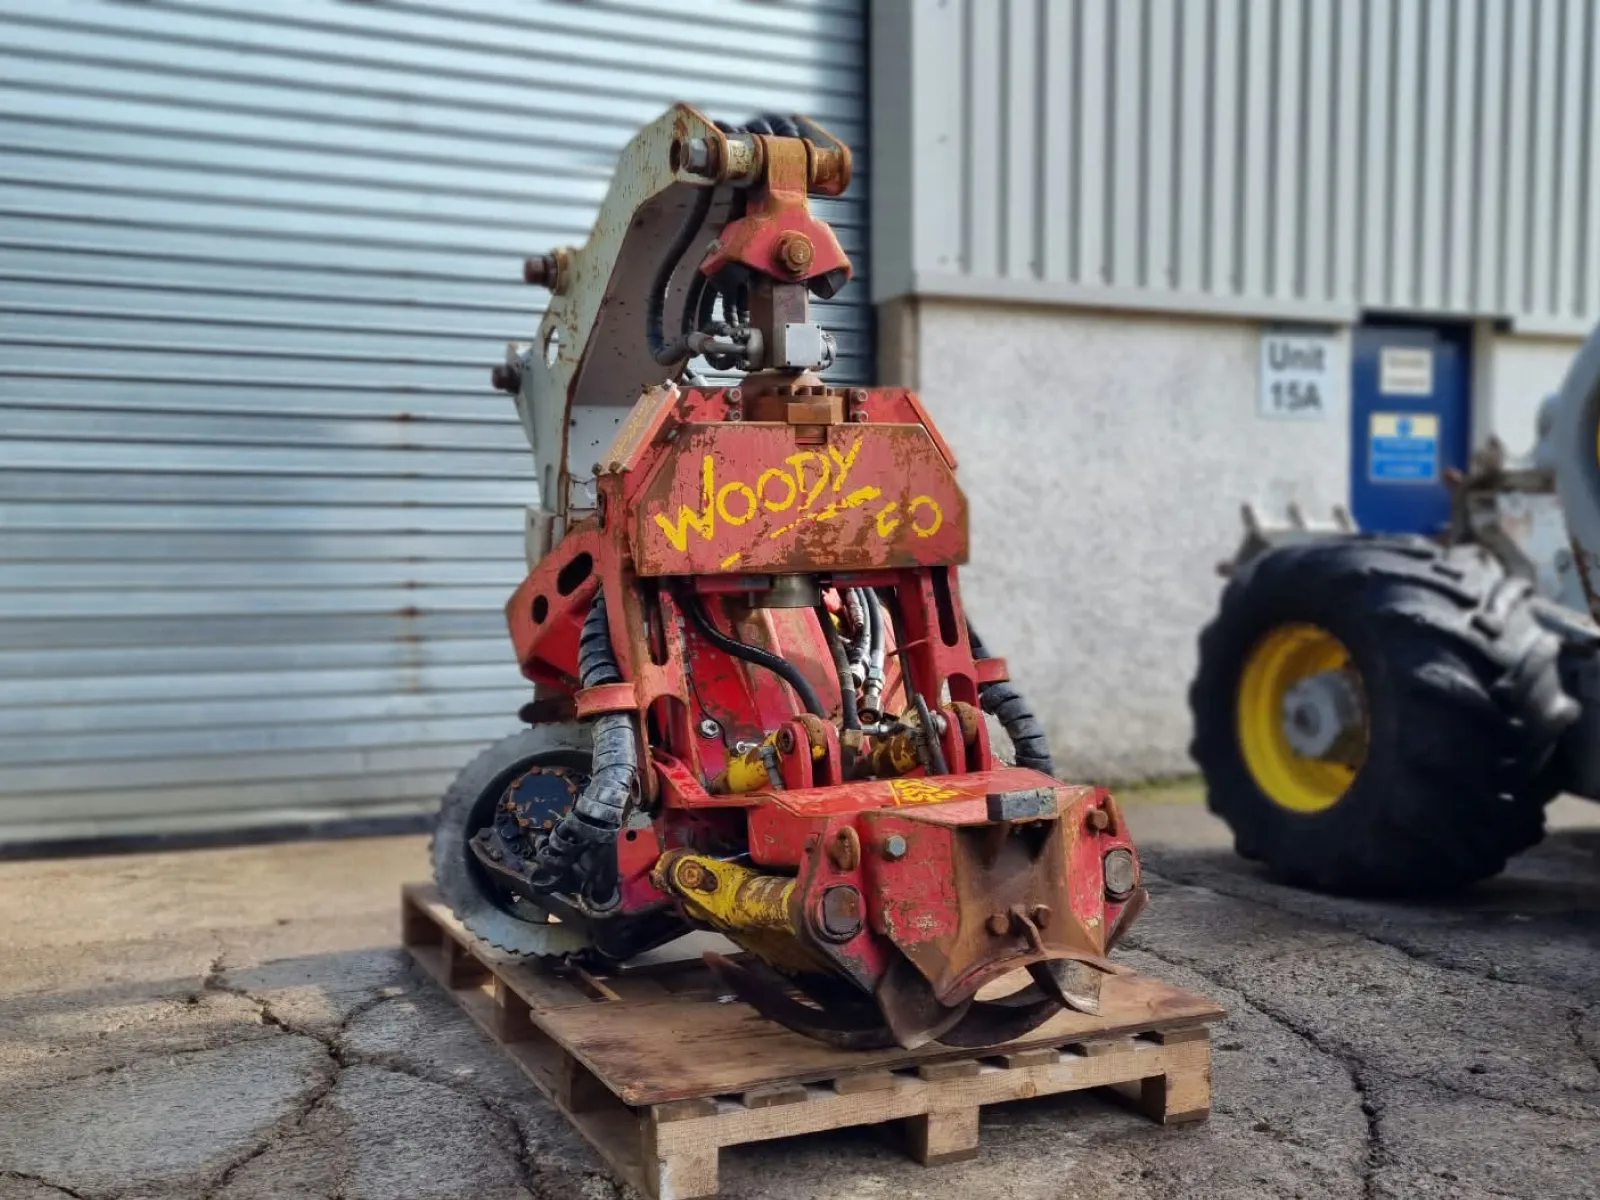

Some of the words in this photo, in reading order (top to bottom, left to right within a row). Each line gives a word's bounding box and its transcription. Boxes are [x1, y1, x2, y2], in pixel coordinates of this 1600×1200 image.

[1269, 341, 1326, 372] Unit
[1270, 380, 1323, 411] 15A
[654, 436, 863, 551] WOODY
